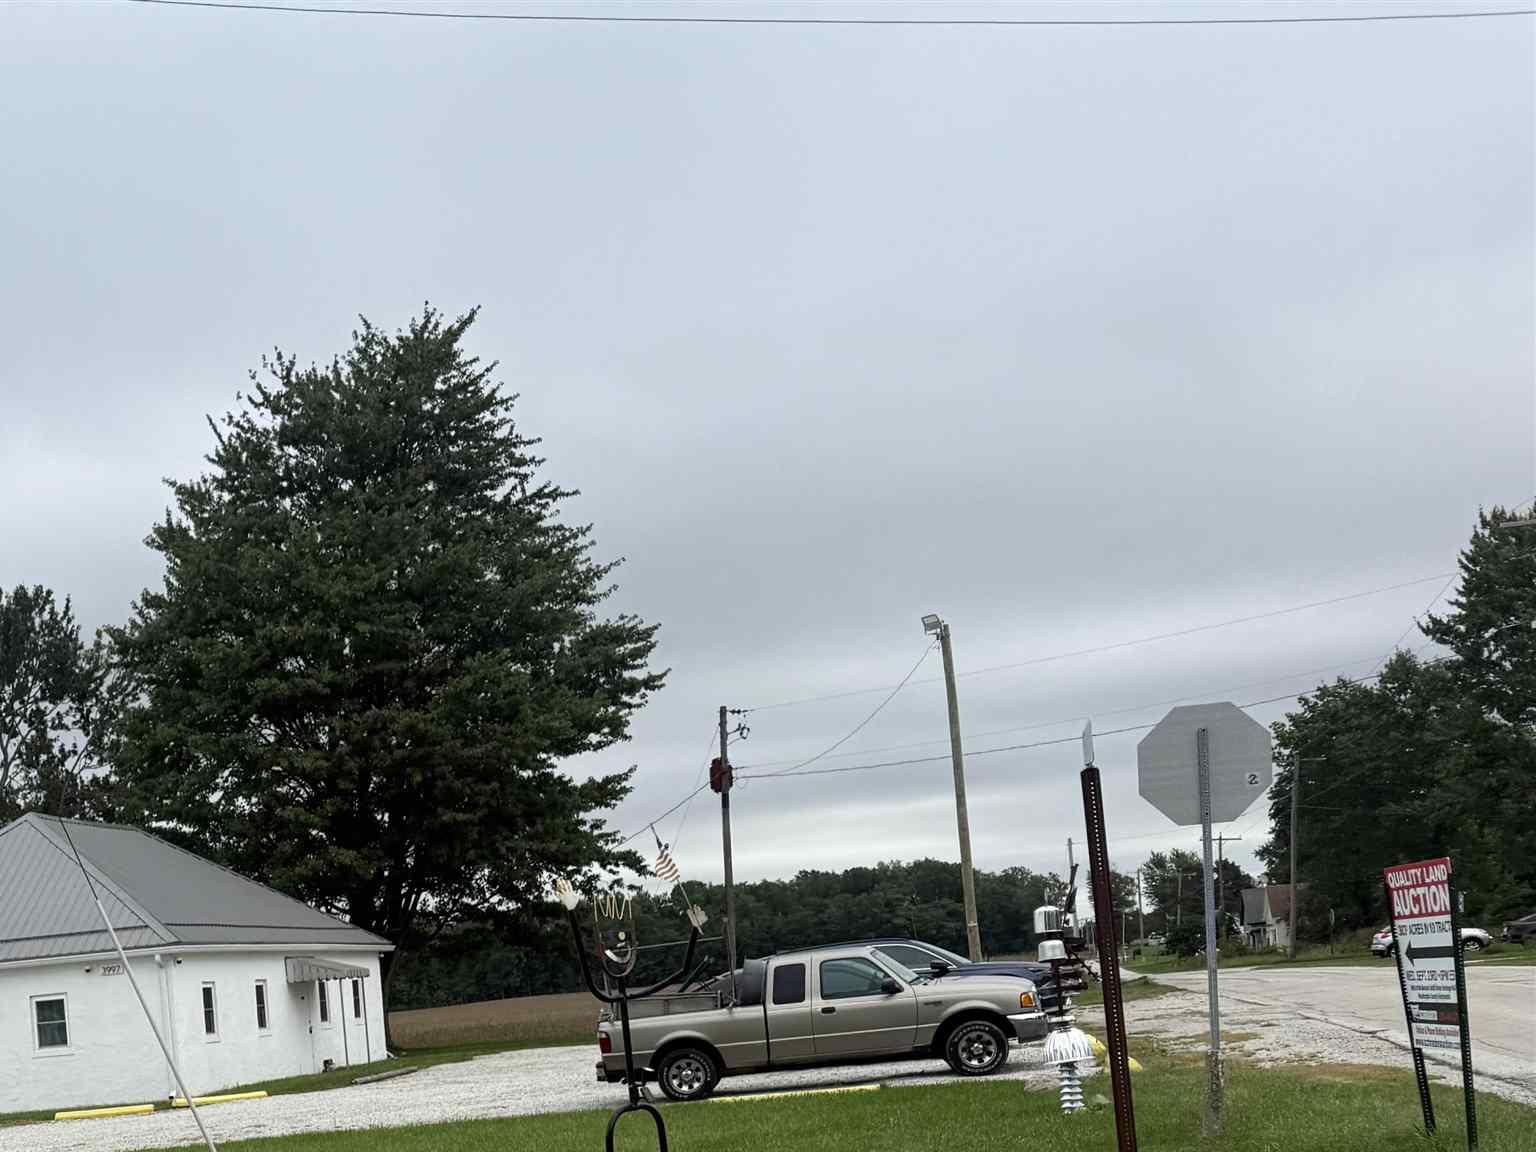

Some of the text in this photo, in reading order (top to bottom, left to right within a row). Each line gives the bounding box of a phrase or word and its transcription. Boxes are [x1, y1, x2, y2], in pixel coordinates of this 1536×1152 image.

[1388, 864, 1447, 888] QUALITY LAND
[1393, 884, 1451, 917] AUCTION
